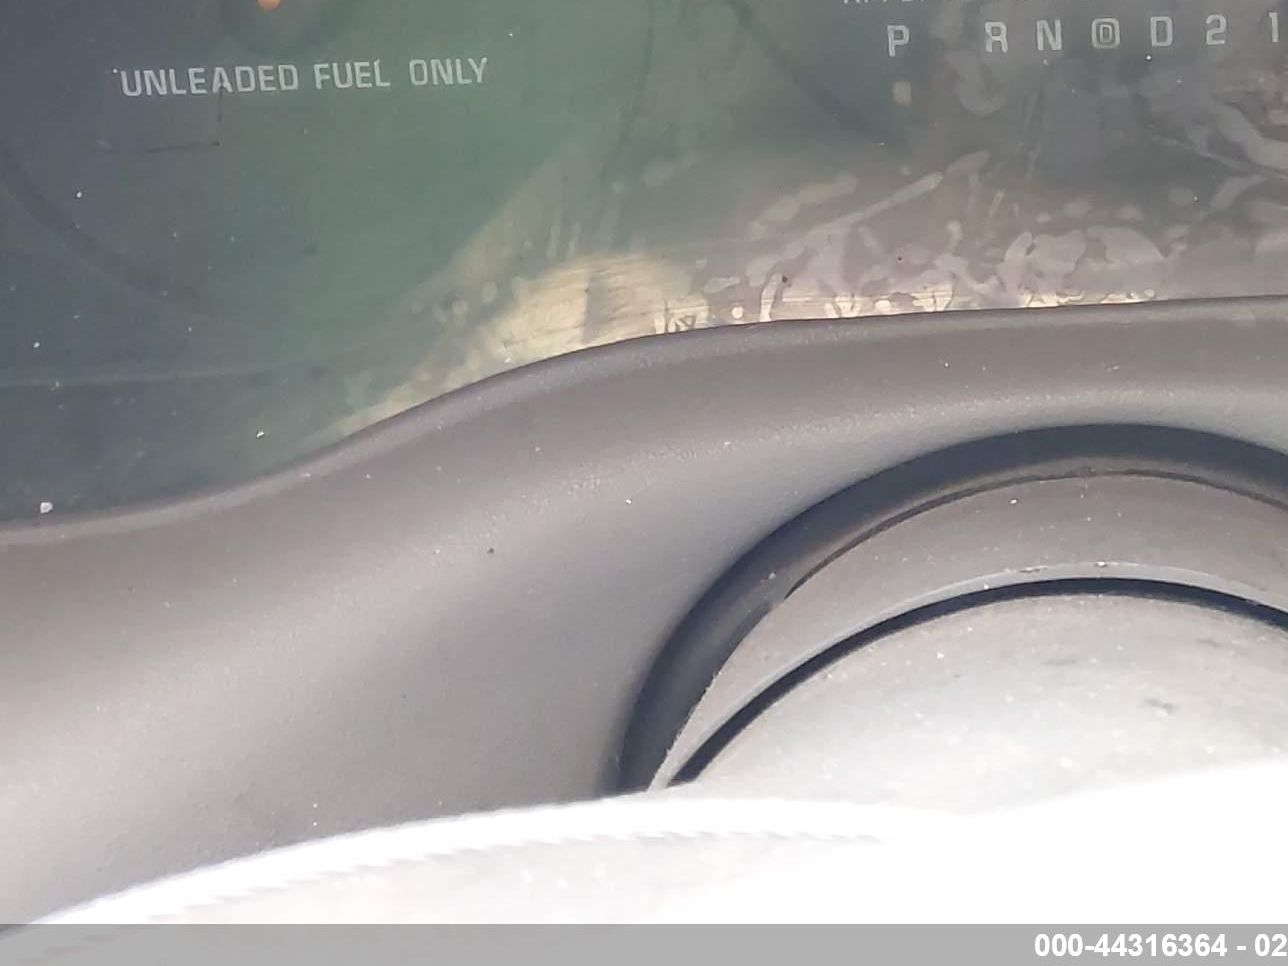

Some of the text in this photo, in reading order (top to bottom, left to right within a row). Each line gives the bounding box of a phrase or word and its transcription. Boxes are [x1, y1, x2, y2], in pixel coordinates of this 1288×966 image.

[886, 24, 910, 56] P
[985, 21, 1009, 53] R
[1036, 19, 1063, 51] N
[1149, 16, 1173, 47] D
[1205, 14, 1227, 45] 2
[1268, 11, 1280, 43] 1
[120, 57, 489, 97] UNLEADED FUEL ONLY
